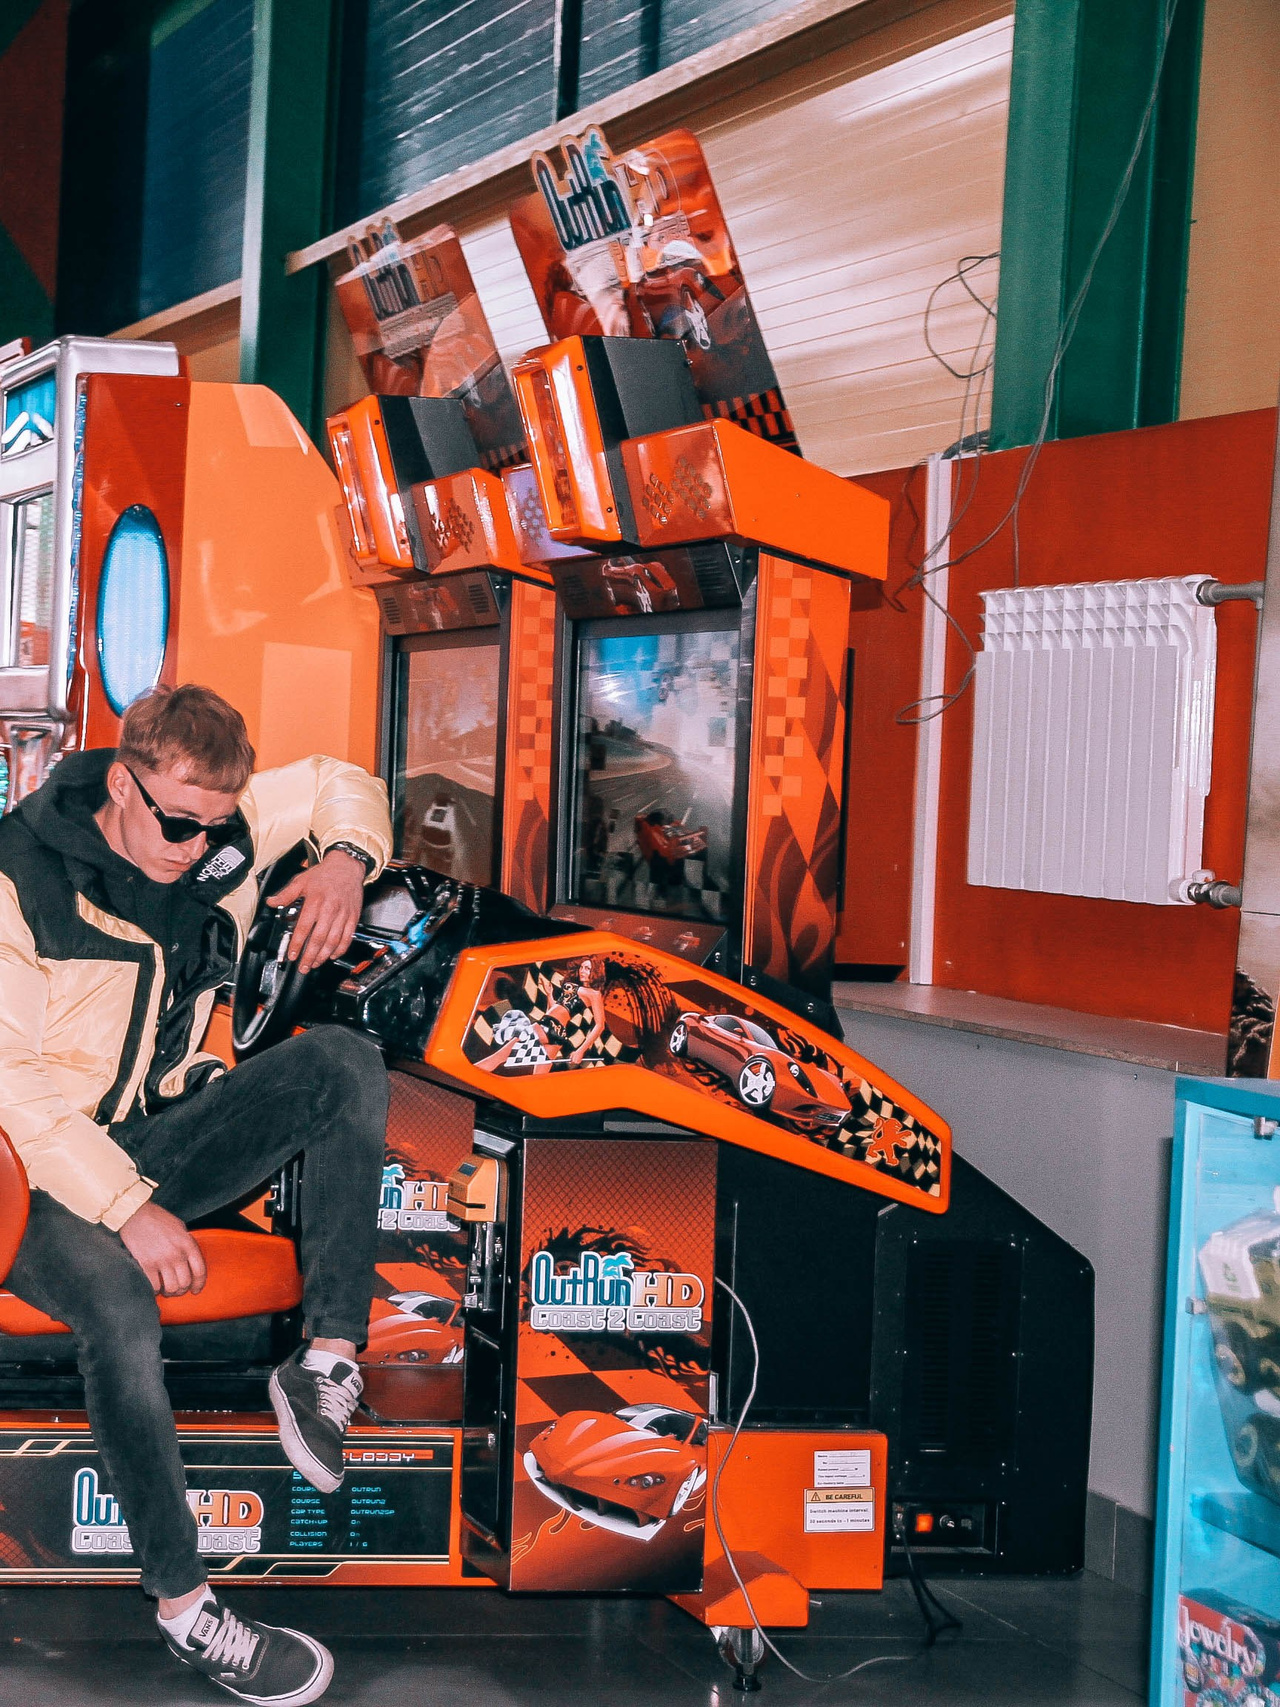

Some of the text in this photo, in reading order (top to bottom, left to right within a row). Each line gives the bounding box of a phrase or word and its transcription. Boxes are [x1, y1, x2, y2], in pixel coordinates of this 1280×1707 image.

[534, 1252, 704, 1308] OutRun HD
[532, 1307, 701, 1331] Coast 2 Coast
[187, 1491, 262, 1528] HD
[74, 1527, 259, 1551] Coas oast
[199, 1617, 214, 1637] VANS
